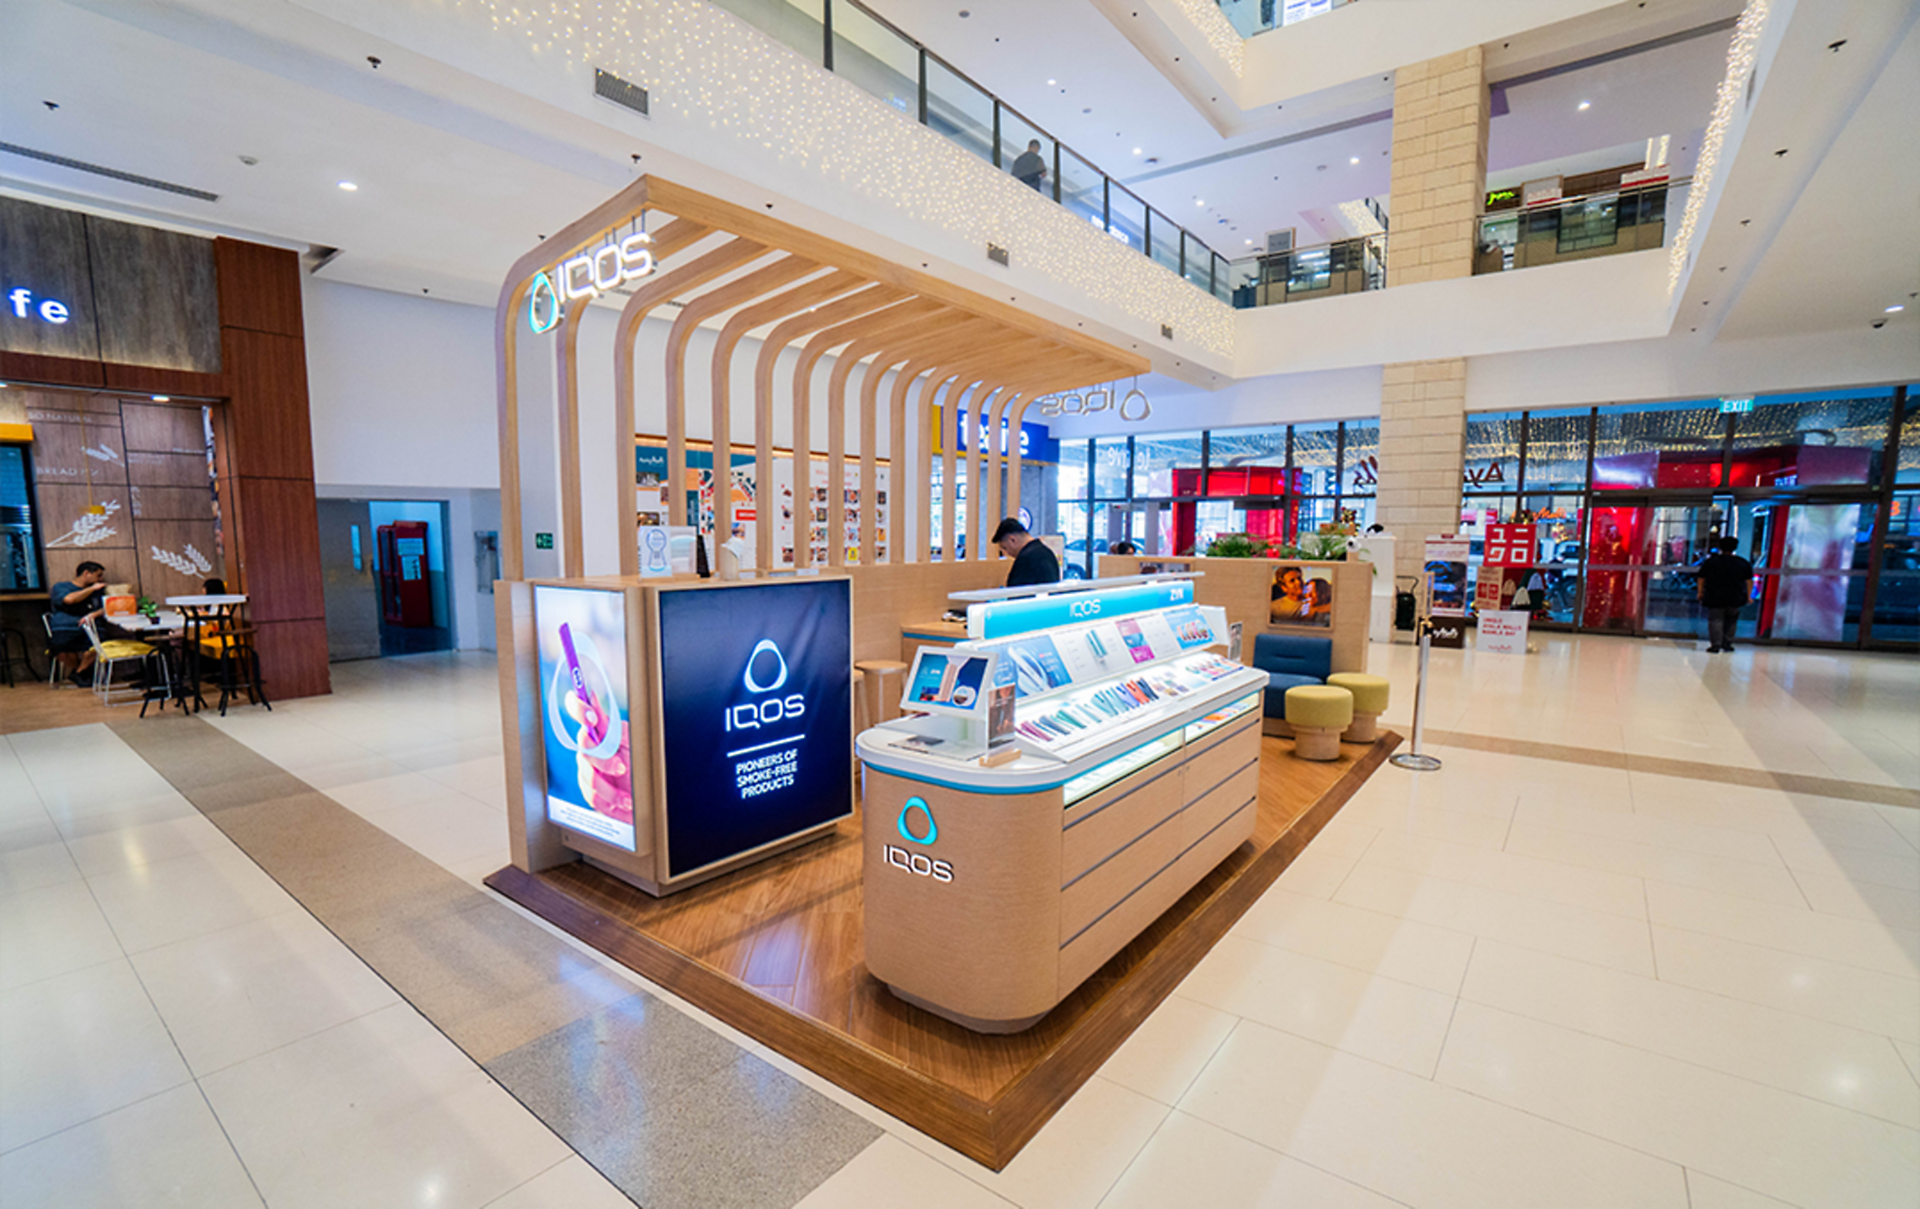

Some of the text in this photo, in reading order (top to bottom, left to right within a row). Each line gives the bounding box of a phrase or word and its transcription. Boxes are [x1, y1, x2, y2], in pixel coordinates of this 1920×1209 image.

[556, 231, 654, 303] IQOS
[9, 288, 69, 324] fe
[1723, 400, 1750, 413] EXIT
[1069, 599, 1101, 617] IQOS
[725, 693, 805, 732] IQOS
[736, 748, 798, 775] PIONEERS OF
[737, 761, 798, 788] SMOKE-FREE
[741, 774, 794, 799] PRODUCTS
[883, 844, 953, 883] IQOS
